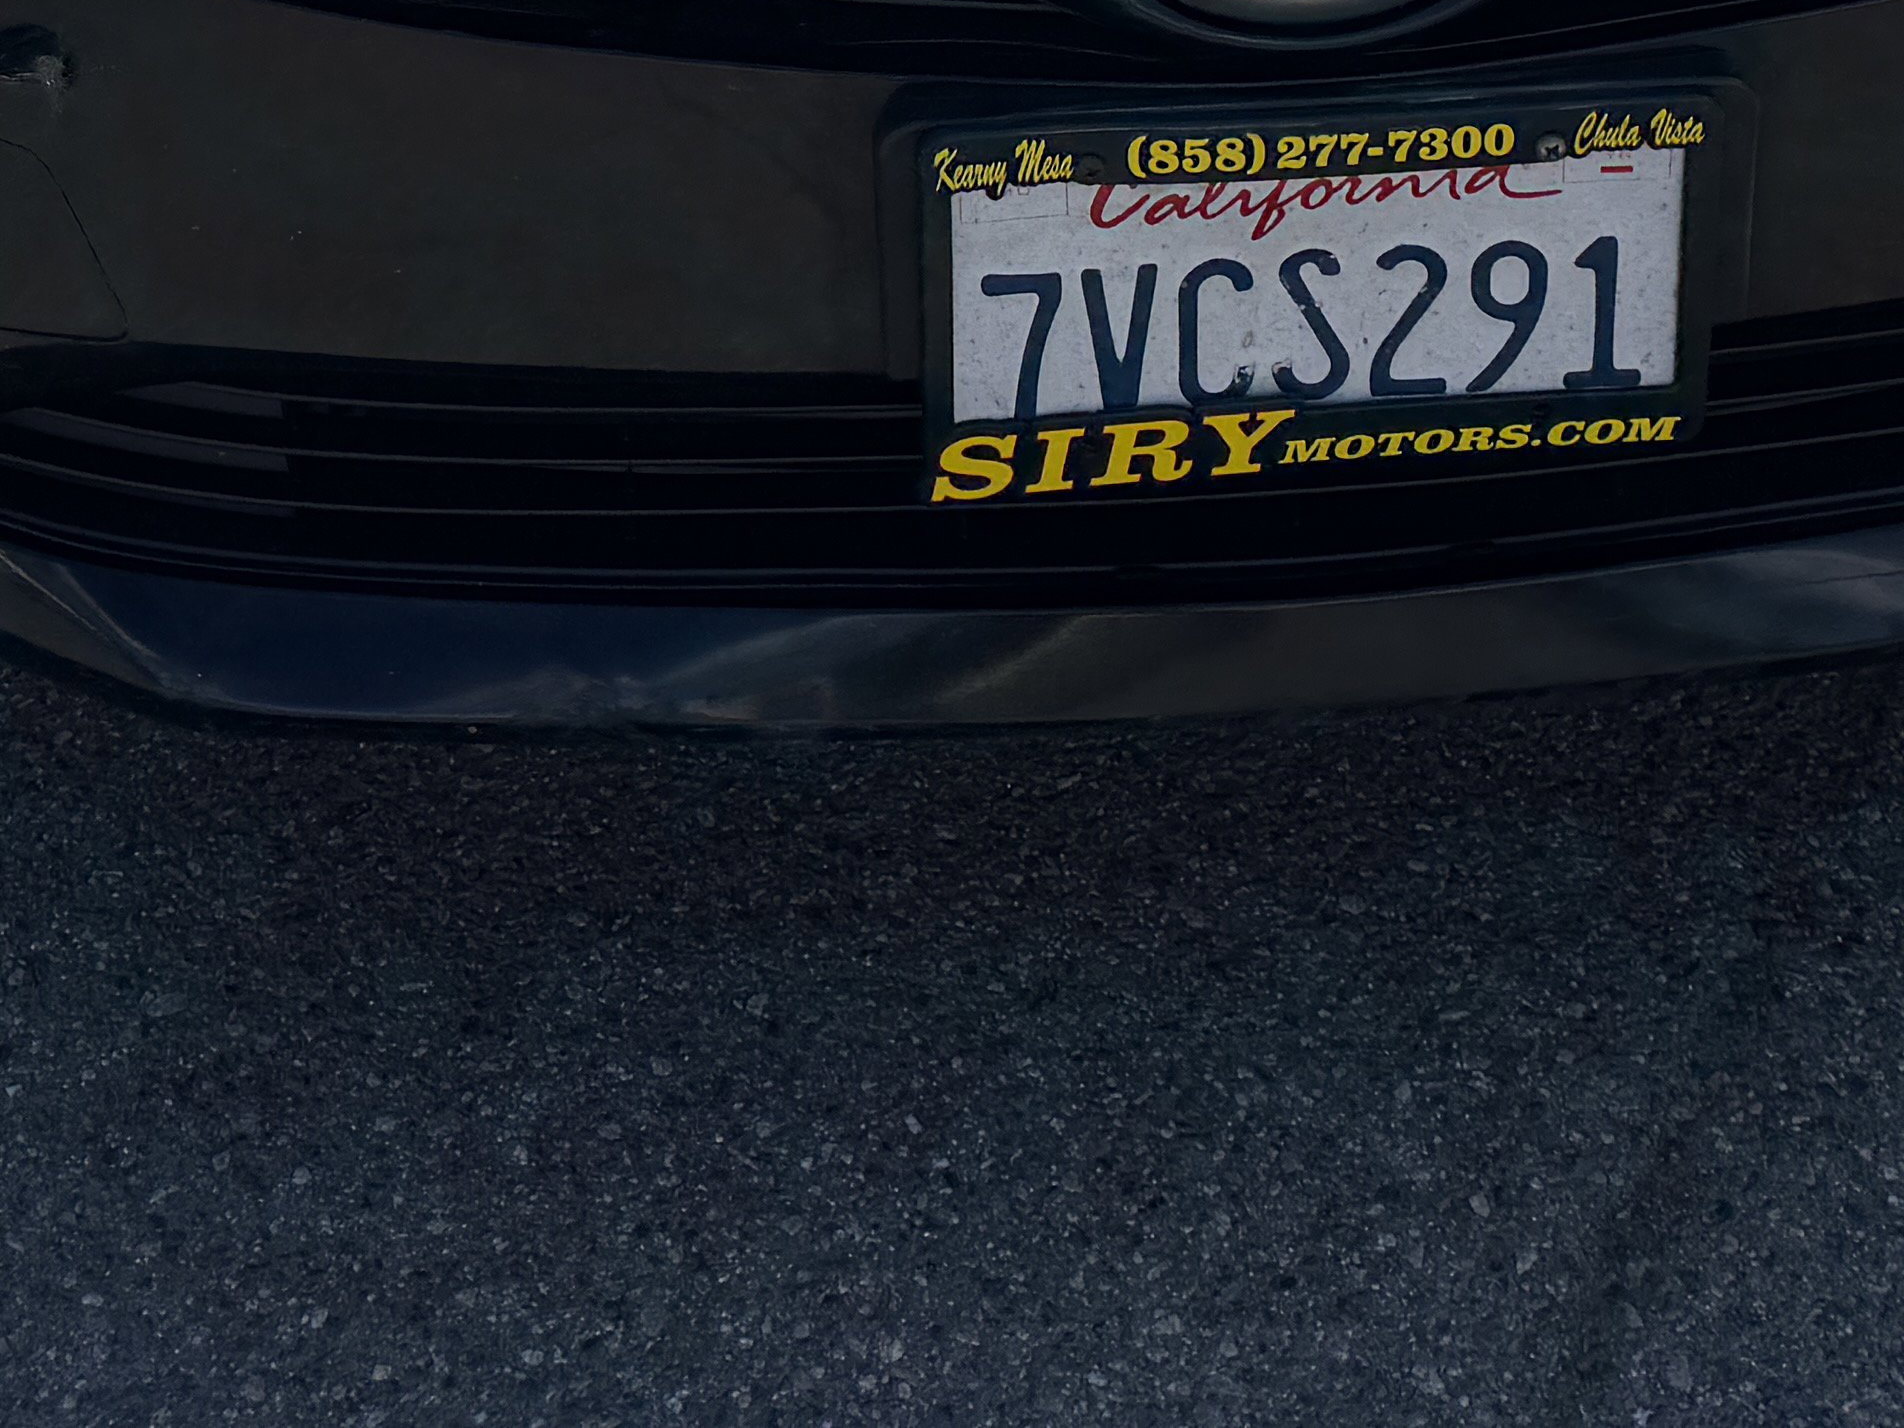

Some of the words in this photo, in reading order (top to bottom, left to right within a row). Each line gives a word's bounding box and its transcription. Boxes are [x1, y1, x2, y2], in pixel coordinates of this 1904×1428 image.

[934, 147, 1008, 195] Kearny
[1014, 138, 1075, 184] Mesa
[1127, 133, 1266, 180] (858)
[1277, 123, 1515, 170] 277-7300
[1574, 110, 1642, 156] Chula
[1650, 108, 1707, 146] Vista
[979, 234, 1642, 421] 7VCS291
